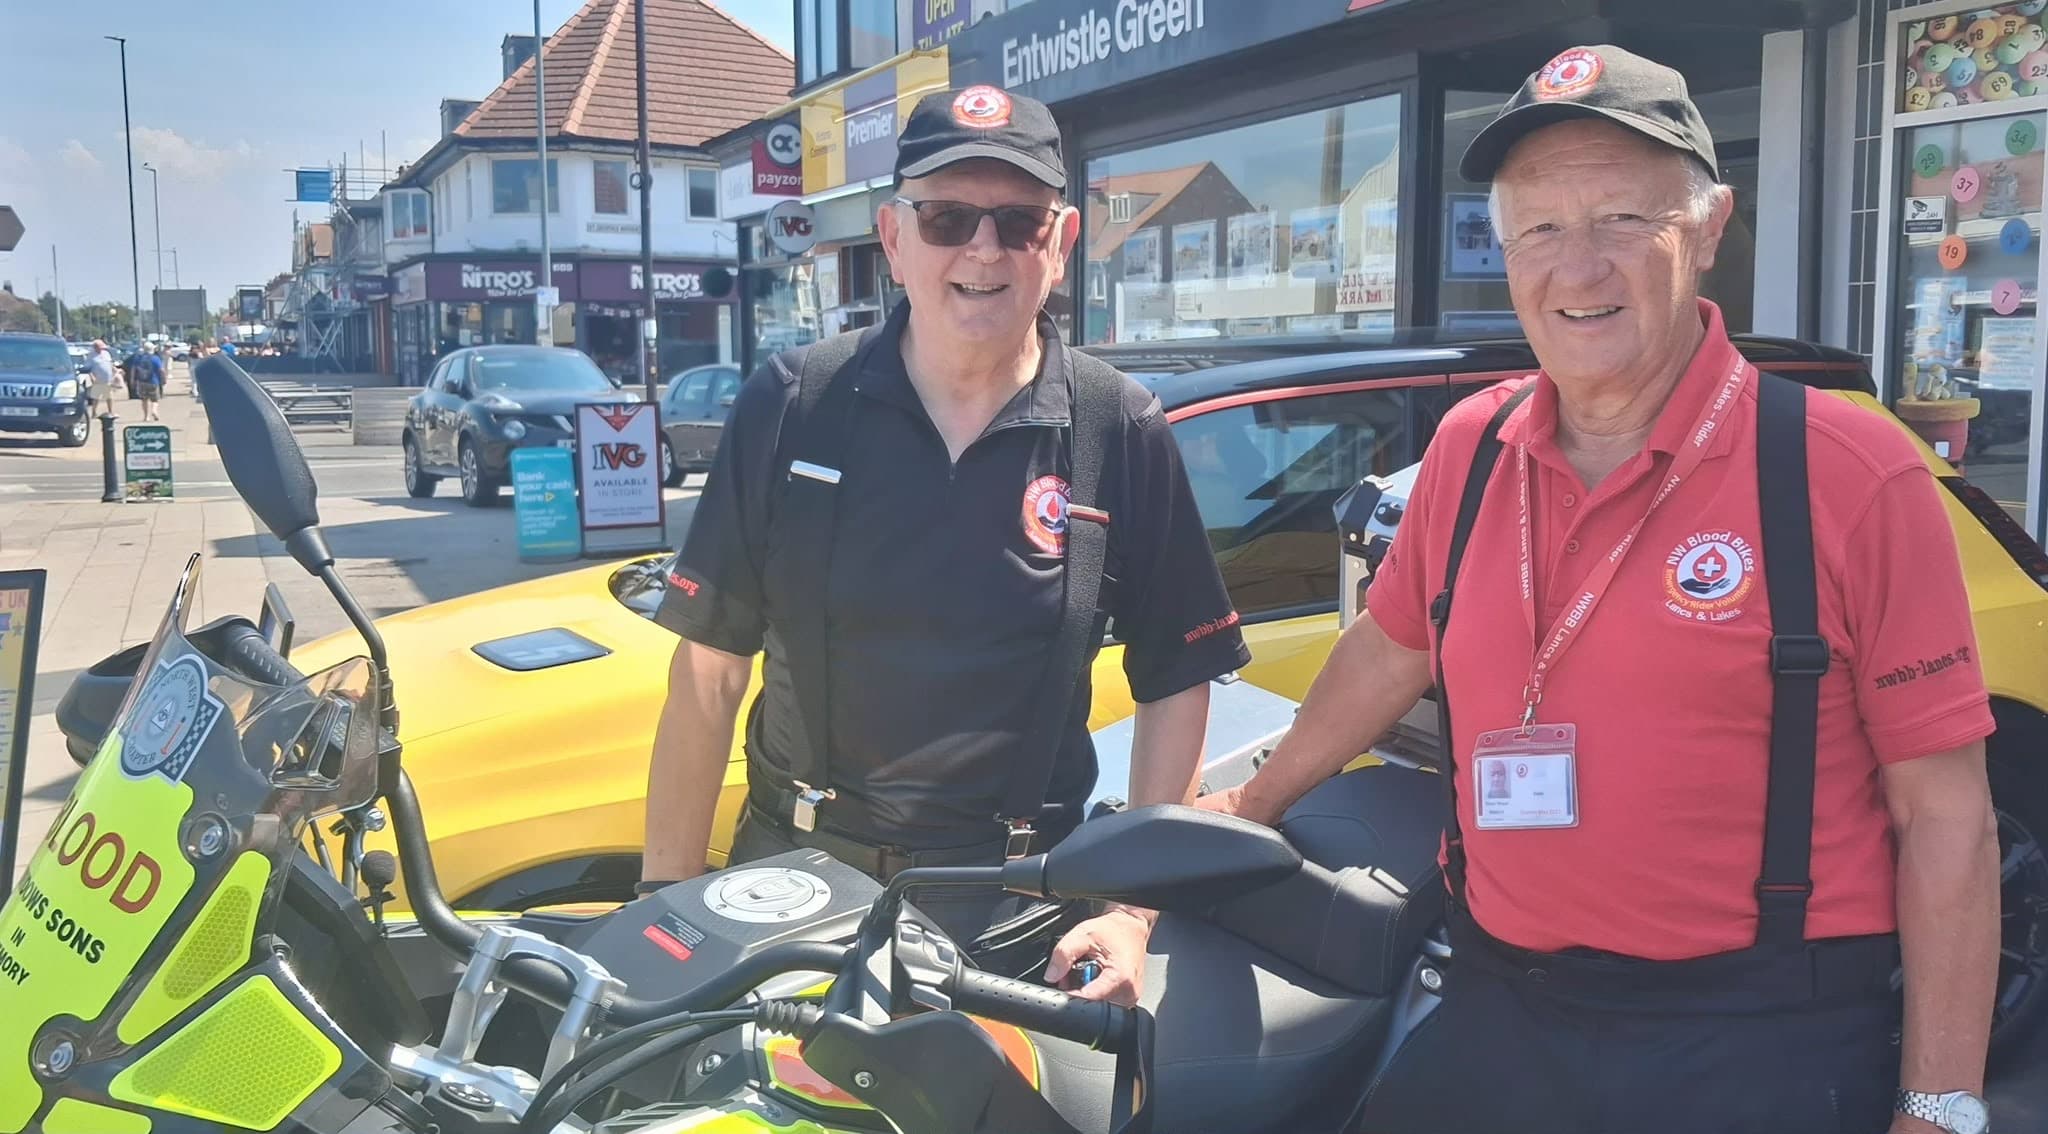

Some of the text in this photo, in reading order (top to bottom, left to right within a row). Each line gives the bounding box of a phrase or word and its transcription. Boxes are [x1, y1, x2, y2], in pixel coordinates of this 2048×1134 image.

[1003, 0, 1205, 90] Entwistle Green
[848, 111, 894, 149] Premier
[2010, 129, 2028, 146] 34
[1920, 153, 1936, 171] 29
[1956, 177, 1974, 194] 37
[774, 215, 813, 238] IVG
[1944, 244, 1960, 260] 19
[461, 269, 535, 290] NITRO'S
[630, 271, 700, 293] NTRO'S
[2001, 290, 2010, 304] 7
[1713, 382, 1737, 411] Lakes
[1693, 419, 1716, 448] Rider
[592, 442, 648, 471] IVG
[516, 471, 546, 482] Bank
[546, 479, 572, 490] cash
[593, 477, 649, 488] AVAILABLE
[611, 487, 643, 497] STORE
[1520, 526, 1529, 561] Lancs
[1667, 531, 1755, 573] NW Blood Bikes
[1520, 561, 1531, 600] NWBB
[1564, 590, 1596, 629] NWBB
[1665, 598, 1742, 621] Lancs & Lakes
[1542, 626, 1571, 660] Lancs
[1537, 661, 1547, 671] &
[10, 925, 27, 948] IN
[45, 907, 106, 965] SONS
